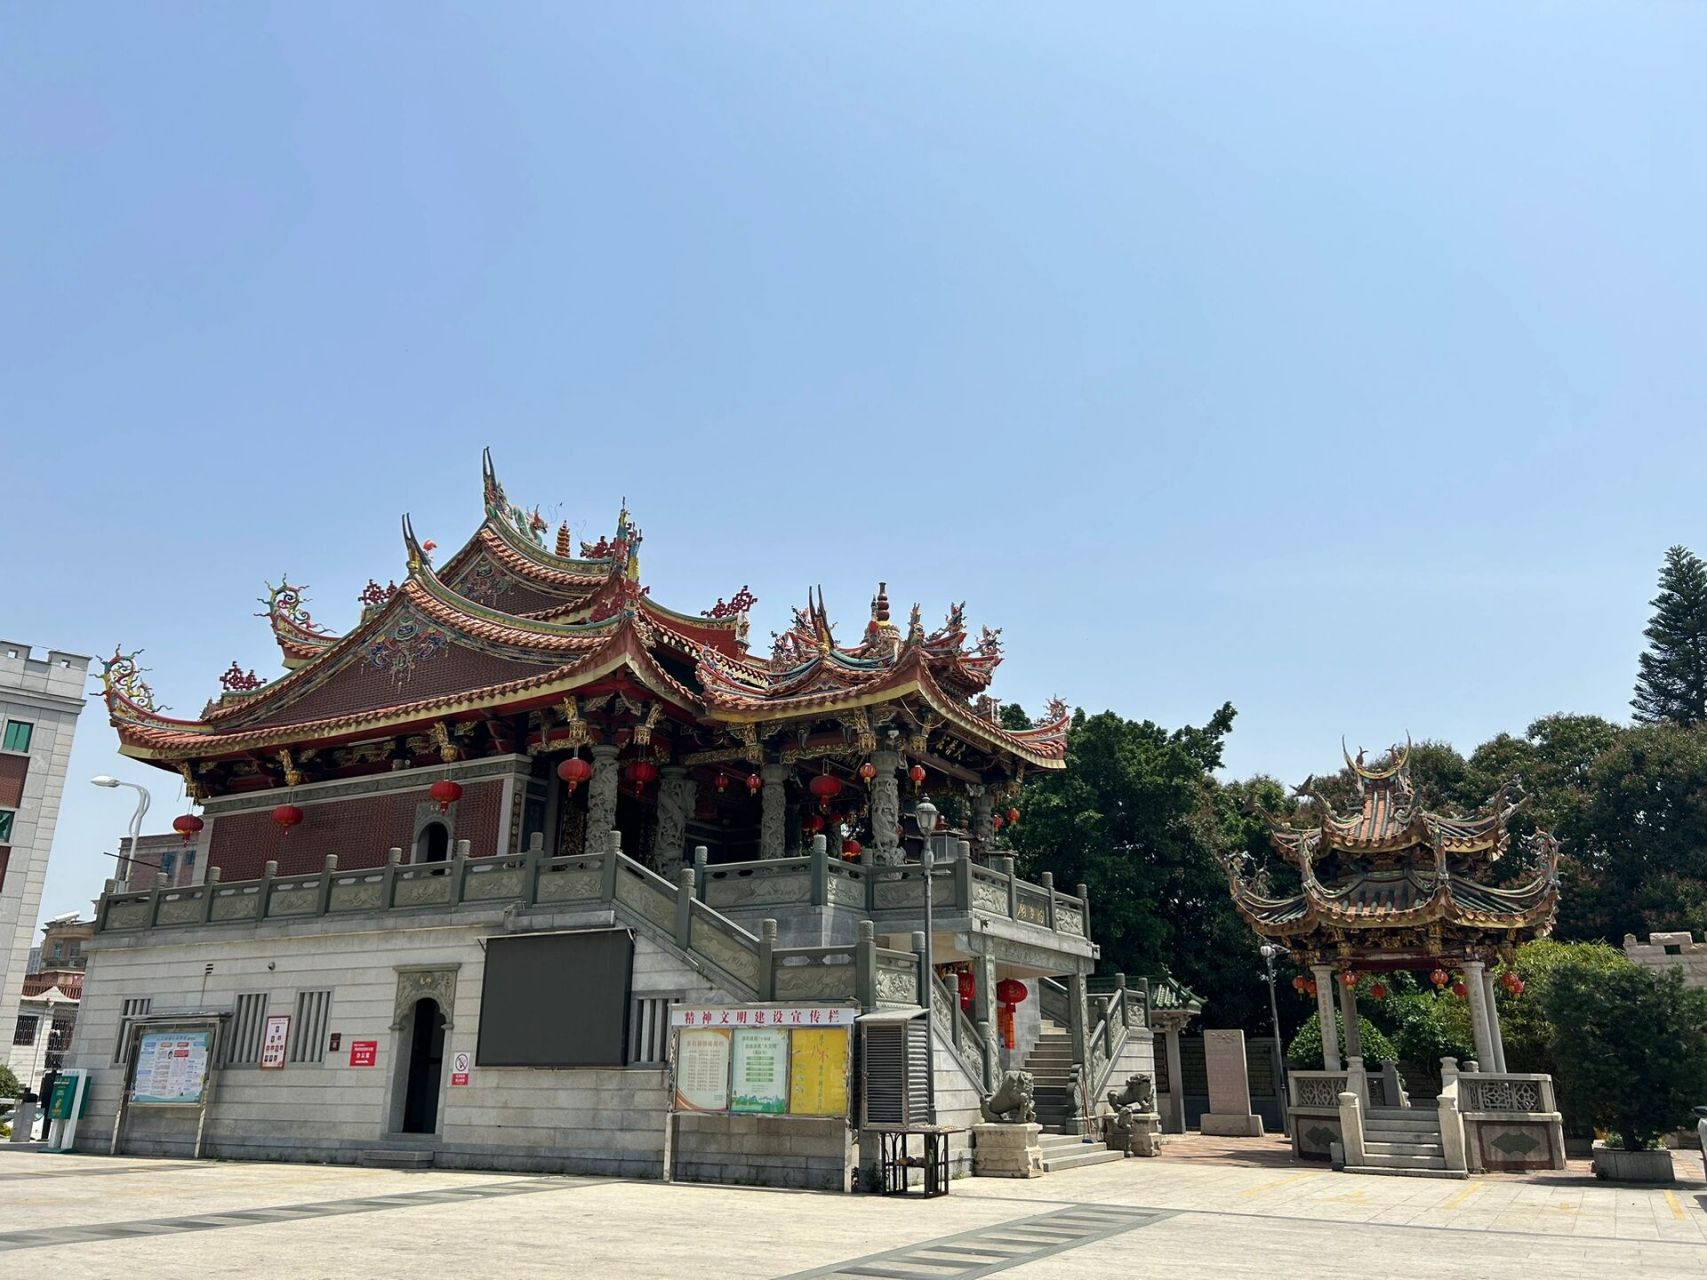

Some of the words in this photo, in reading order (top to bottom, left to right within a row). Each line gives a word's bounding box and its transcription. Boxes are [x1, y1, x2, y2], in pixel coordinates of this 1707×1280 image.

[684, 1009, 840, 1025] 精神文明建设宣传栏
